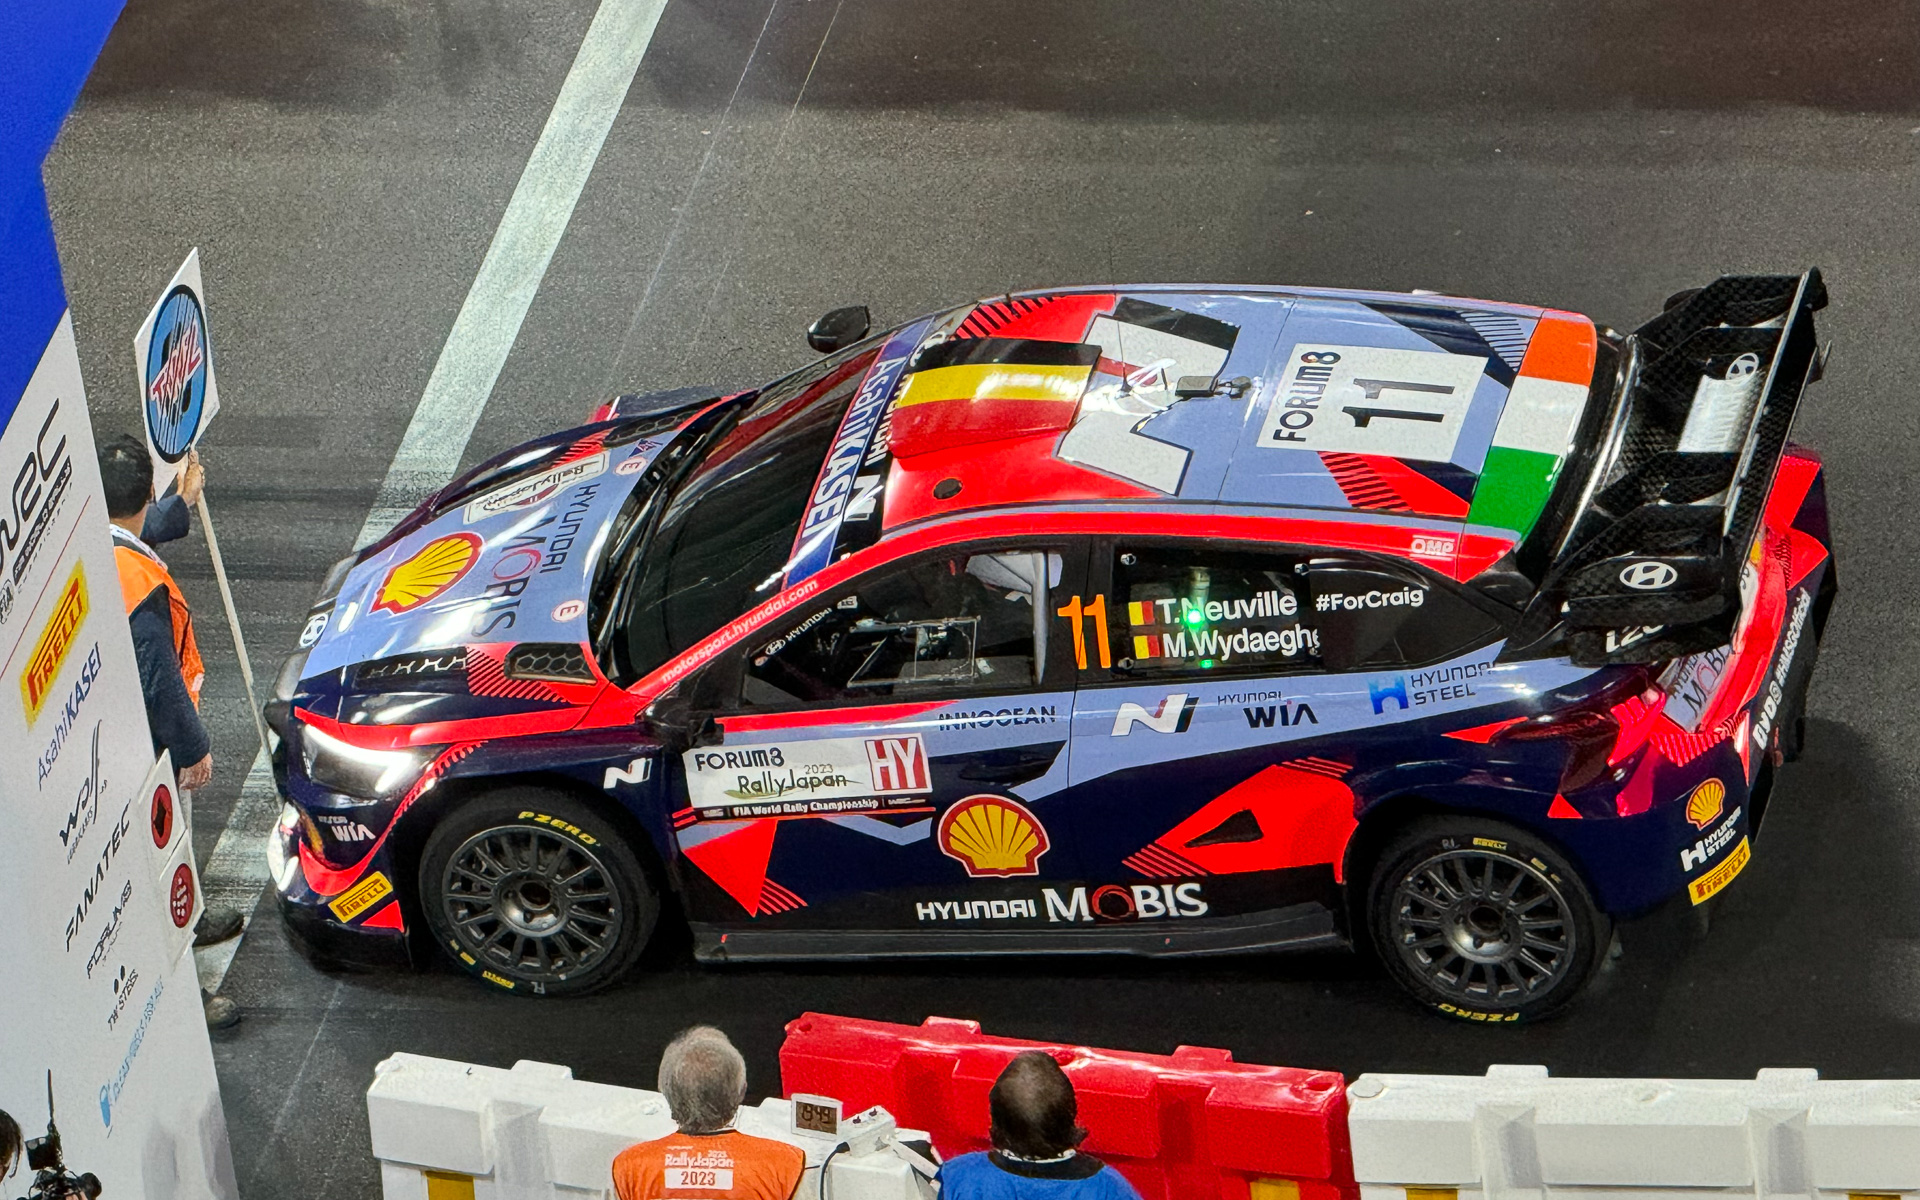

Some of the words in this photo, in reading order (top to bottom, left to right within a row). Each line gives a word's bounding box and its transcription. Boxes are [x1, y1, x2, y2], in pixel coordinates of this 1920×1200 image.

[1273, 351, 1341, 441] FORUM8
[1342, 378, 1455, 427] 11
[539, 483, 601, 574] HYUNDAI
[1411, 538, 1454, 555] OMP
[1155, 590, 1298, 625] T.Neuville
[1315, 587, 1424, 612] #ForCraig
[28, 578, 82, 710] PIRELLI
[661, 579, 819, 684] motorsport.hyundai.com
[1057, 593, 1112, 670] 11
[1217, 690, 1282, 706] HYUNDAI
[1414, 683, 1476, 706] STEEL
[938, 705, 1056, 731] INNOCEAN
[695, 746, 785, 772] FORUM8
[803, 763, 833, 776] 2023
[866, 737, 918, 790] HY
[66, 798, 132, 952] FANATEC
[335, 877, 387, 917] PIRELLI
[915, 898, 1037, 920] HYUNDAI
[1041, 882, 1209, 923] MOBIS
[680, 1170, 716, 1187] 2023
